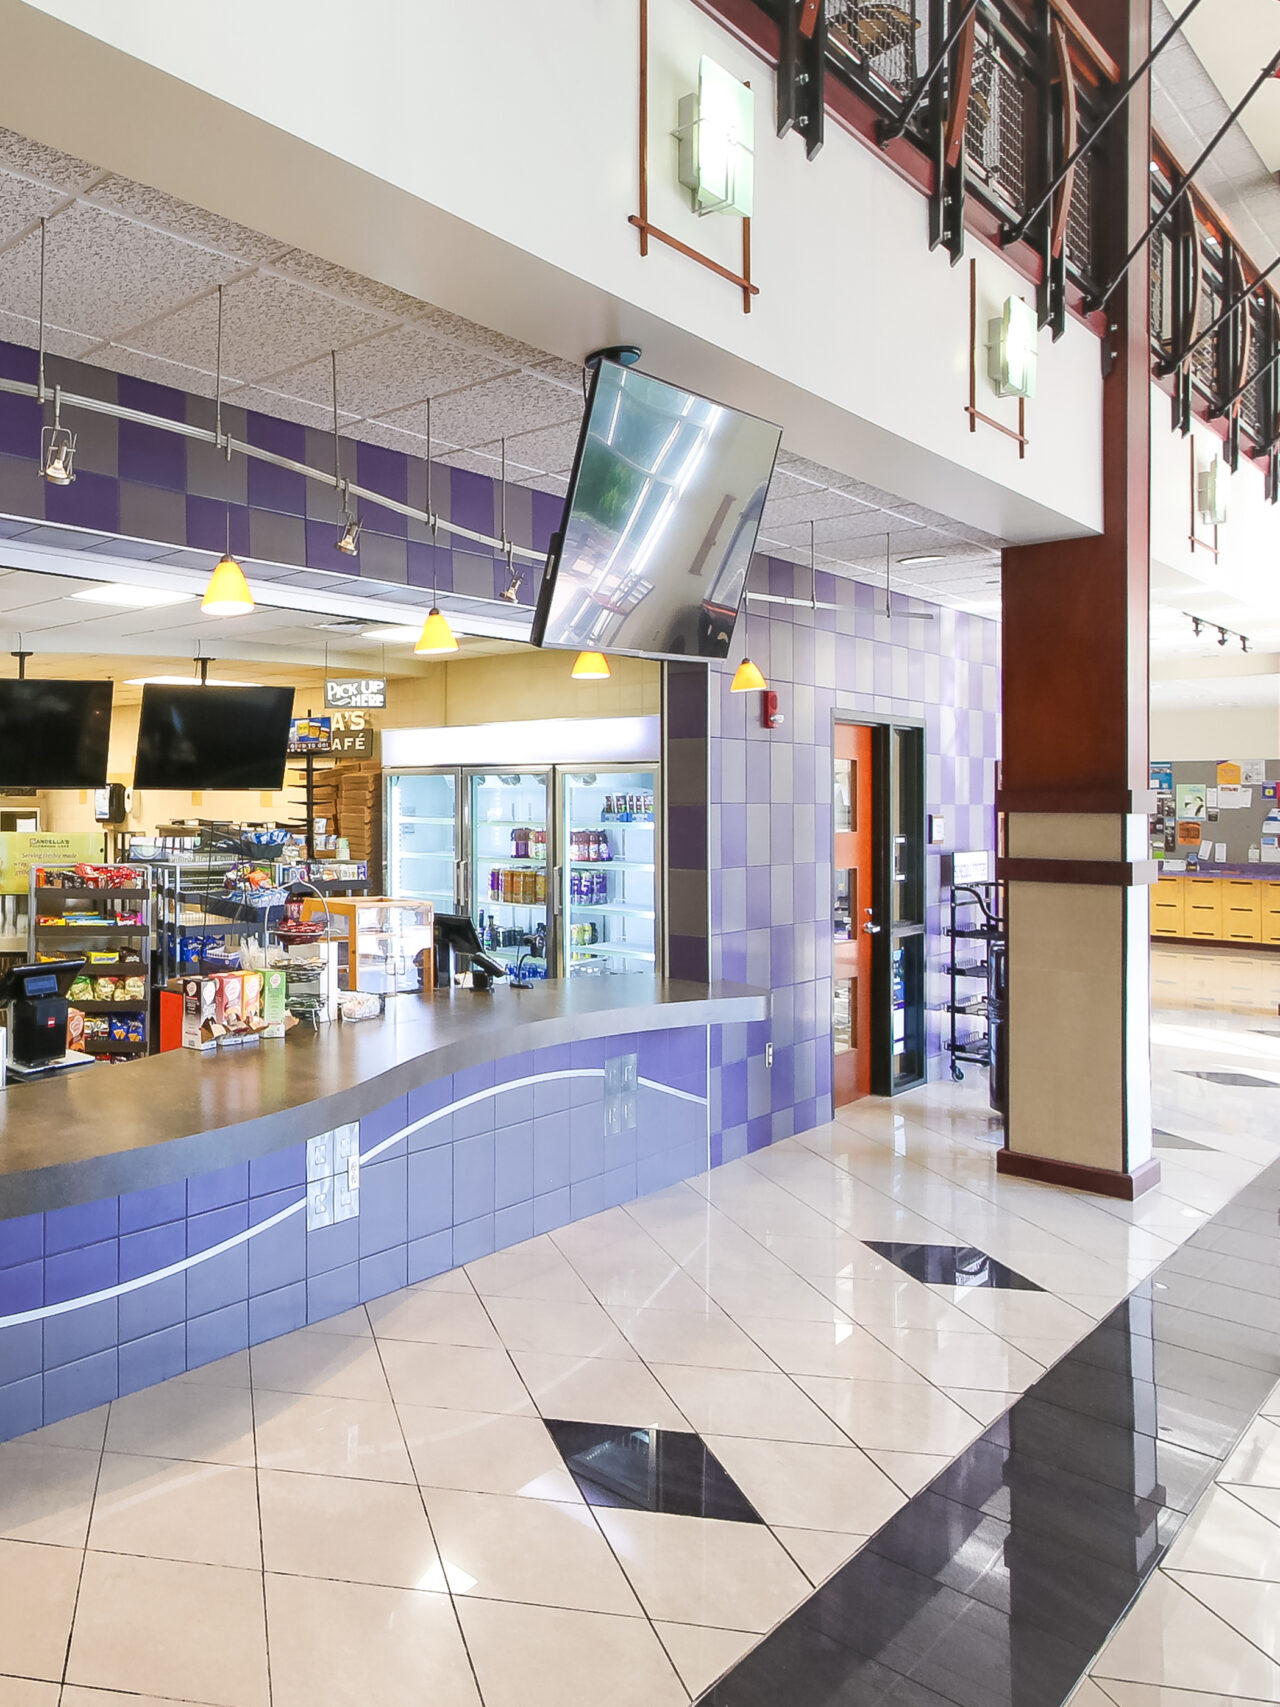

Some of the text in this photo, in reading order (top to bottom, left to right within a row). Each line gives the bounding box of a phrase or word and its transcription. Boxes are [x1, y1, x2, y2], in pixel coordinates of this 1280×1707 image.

[326, 680, 384, 700] PICK UP
[350, 694, 384, 707] HERE
